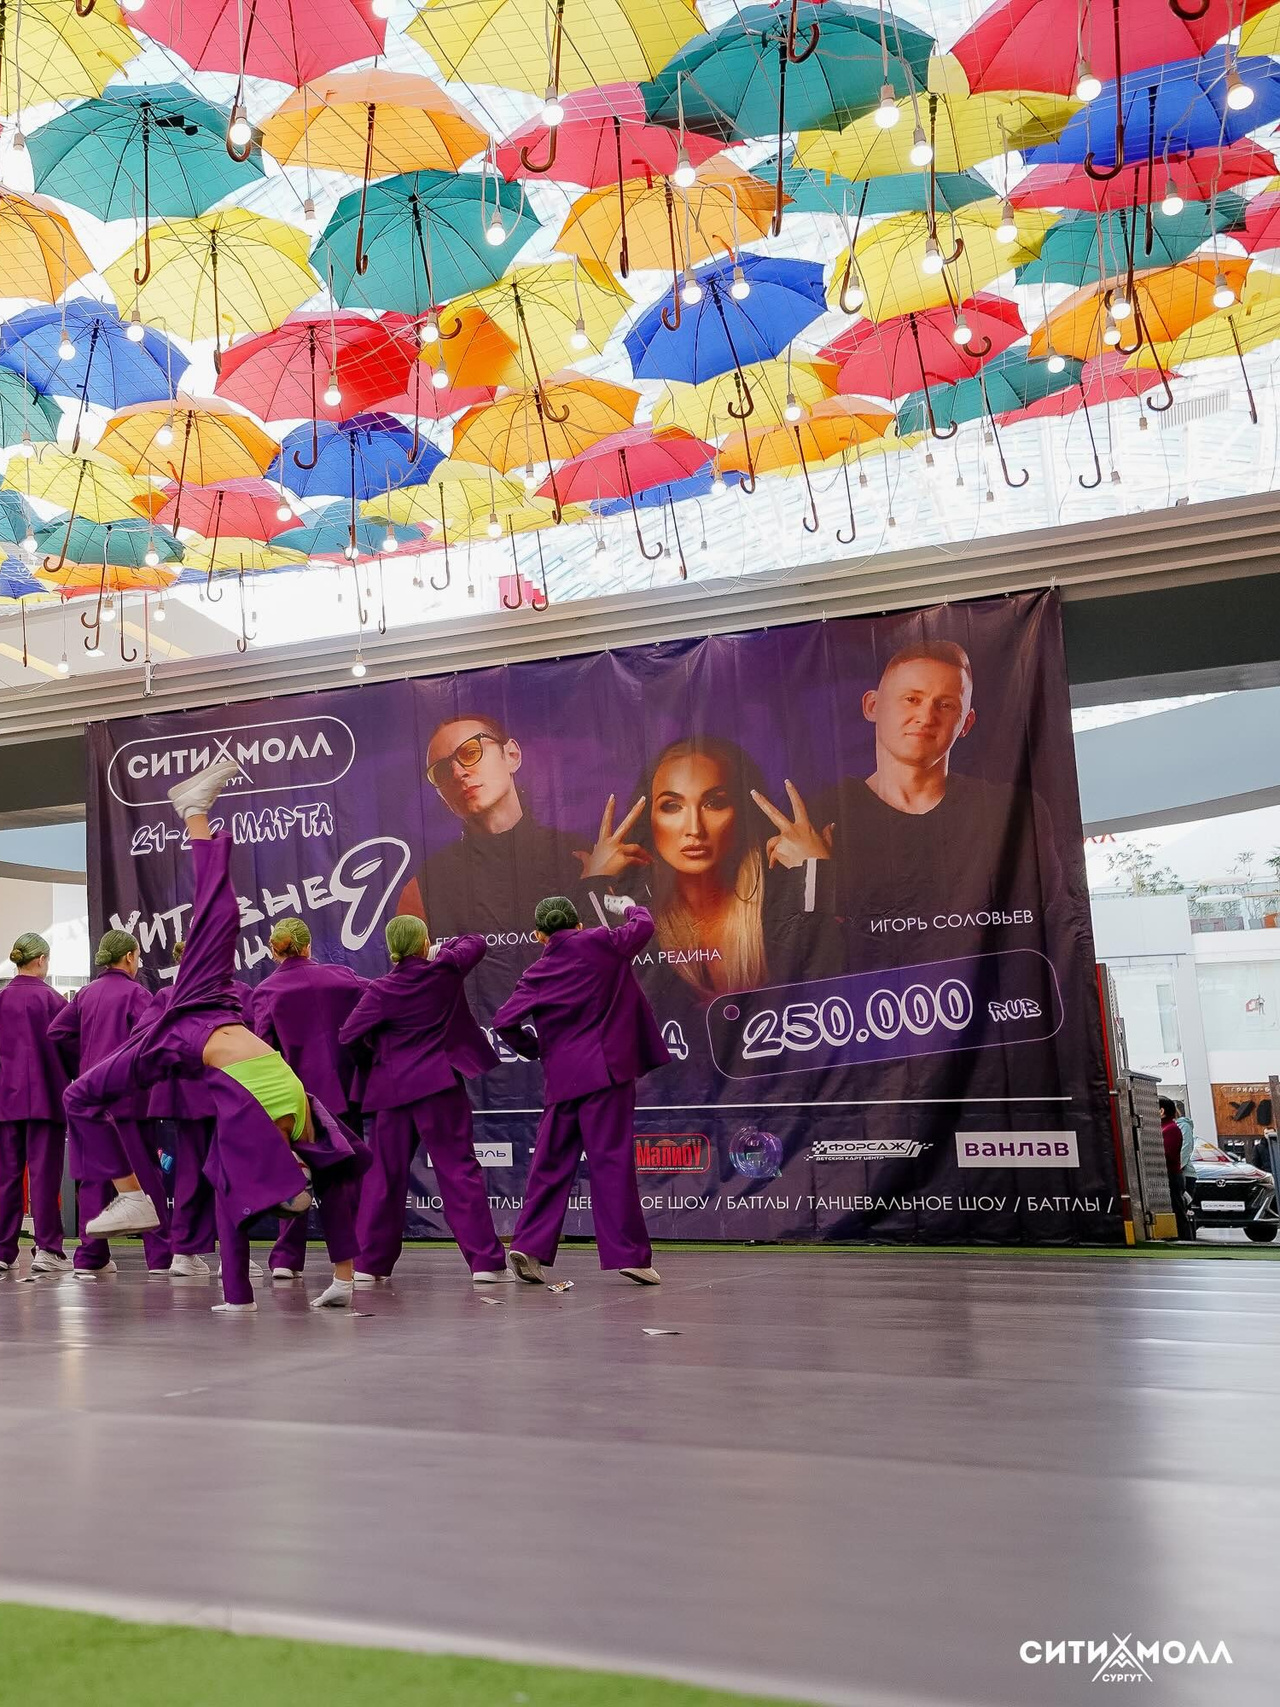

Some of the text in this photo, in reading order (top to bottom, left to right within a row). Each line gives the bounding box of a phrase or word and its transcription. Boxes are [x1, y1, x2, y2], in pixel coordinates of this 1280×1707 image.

[232, 802, 334, 845] МАРТА
[870, 909, 1034, 933] ИГОРЬ СОЛОВЬЕВ
[658, 948, 722, 965] РЕДИНА
[742, 978, 973, 1060] 250.000
[988, 998, 1042, 1023] RUB
[828, 1142, 907, 1152] ФОРСАЖ
[964, 1142, 1070, 1157] ванлав
[416, 1196, 444, 1209] ШО
[487, 1196, 524, 1209] ТТЛЫ
[668, 1196, 710, 1210] ШОУ
[727, 1196, 789, 1210] БАТТЛЫ
[807, 1195, 953, 1212] ТАНЦЕВАЛЬНОЕ
[958, 1196, 1007, 1211] ШОУ
[1027, 1196, 1100, 1213] БАТТЛЫ
